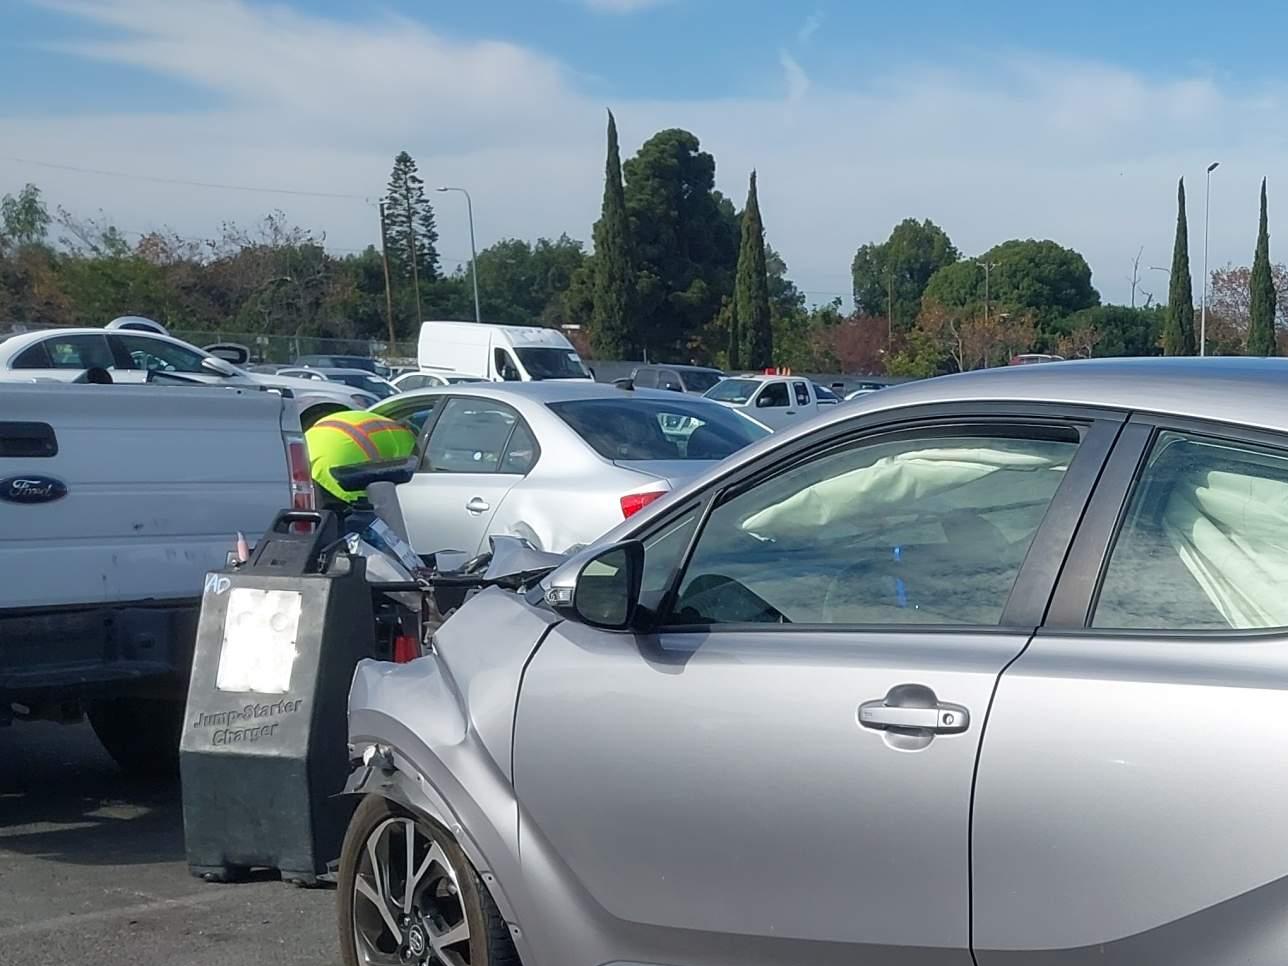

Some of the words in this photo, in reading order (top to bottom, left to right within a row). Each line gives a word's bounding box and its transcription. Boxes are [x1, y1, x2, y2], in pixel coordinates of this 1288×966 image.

[9, 479, 53, 497] Ford
[193, 698, 303, 729] Jump-Starter
[211, 722, 280, 746] Charger
